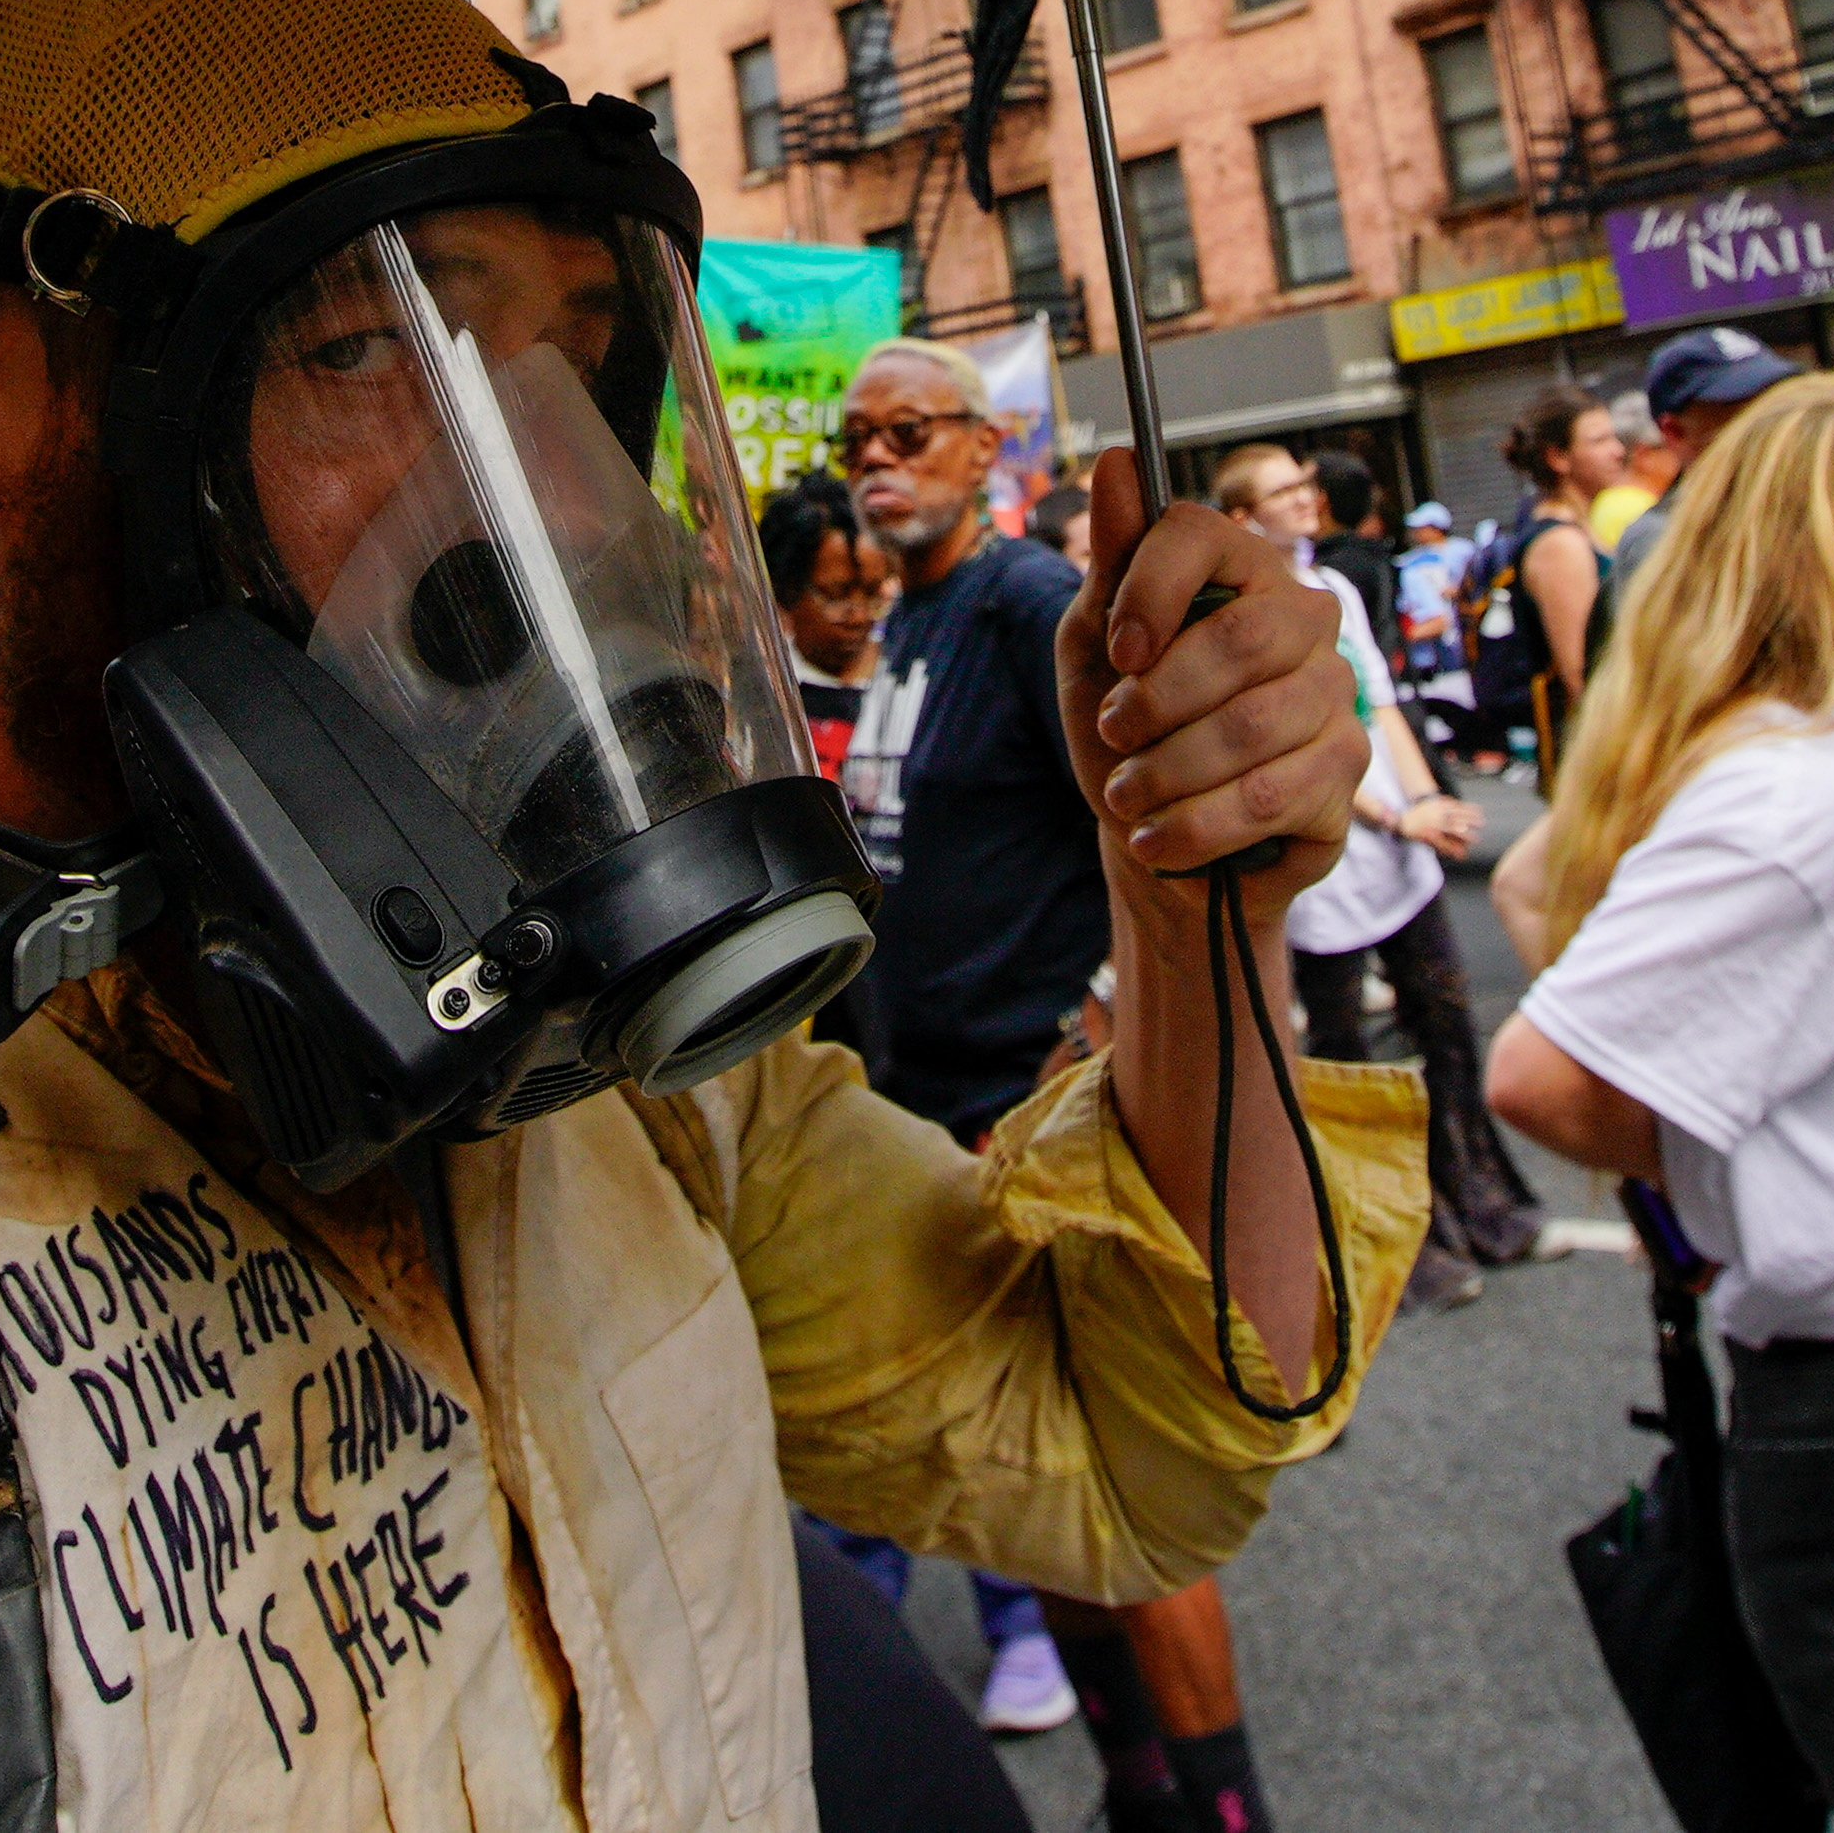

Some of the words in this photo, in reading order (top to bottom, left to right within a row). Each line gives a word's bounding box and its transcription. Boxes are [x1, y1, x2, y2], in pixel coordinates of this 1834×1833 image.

[68, 1315, 236, 1470] DYING
[52, 1409, 279, 1705] CLIMATE
[238, 1591, 317, 1772] IS
[305, 1469, 471, 1713] HERE
